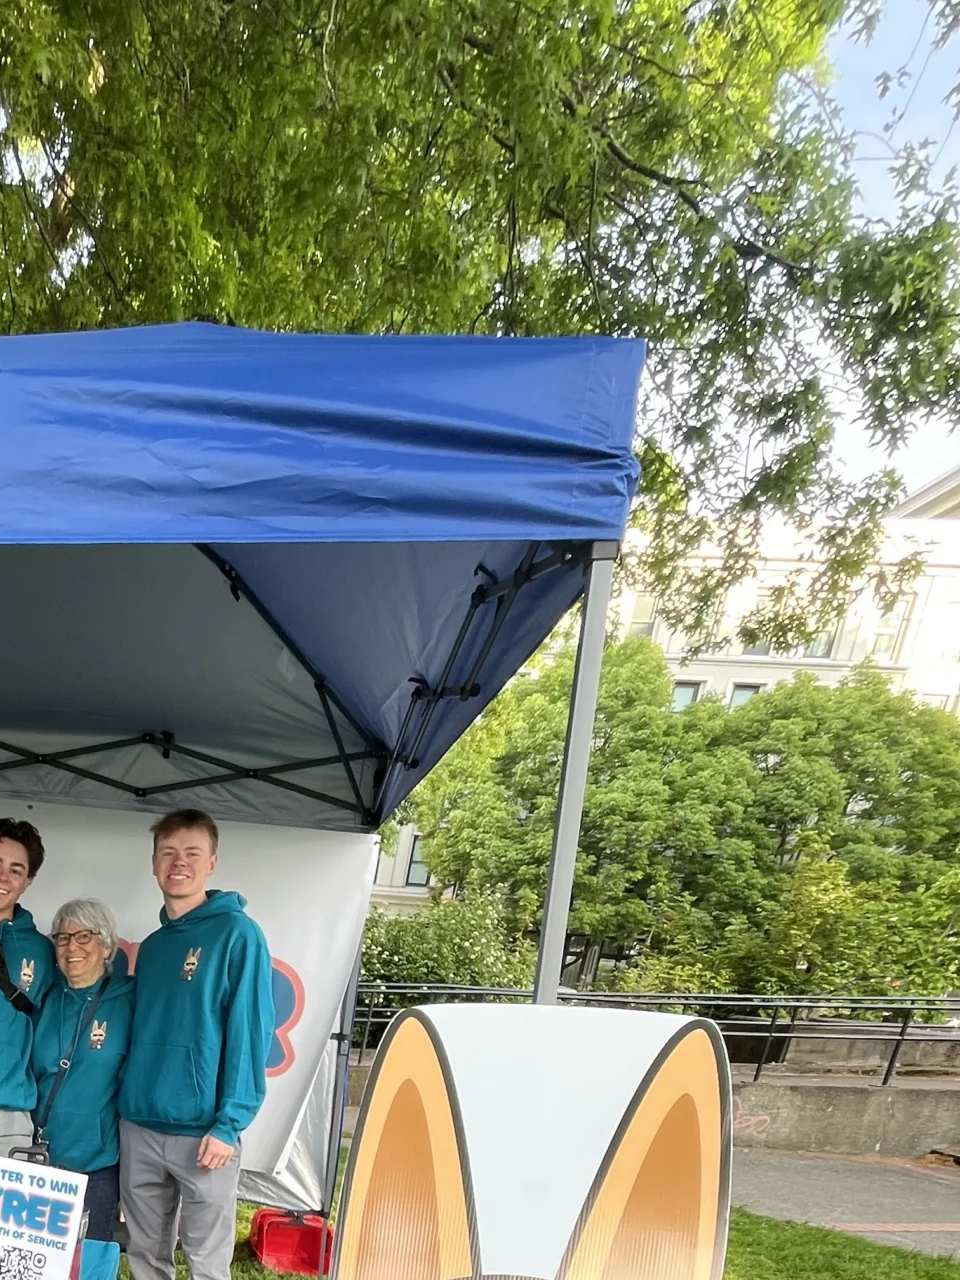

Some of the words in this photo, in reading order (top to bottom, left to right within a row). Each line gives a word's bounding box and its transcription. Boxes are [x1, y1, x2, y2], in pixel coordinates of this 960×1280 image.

[28, 1174, 46, 1189] TO
[50, 1179, 79, 1197] WIN
[12, 1230, 25, 1240] OF
[27, 1234, 67, 1251] SERVICE
